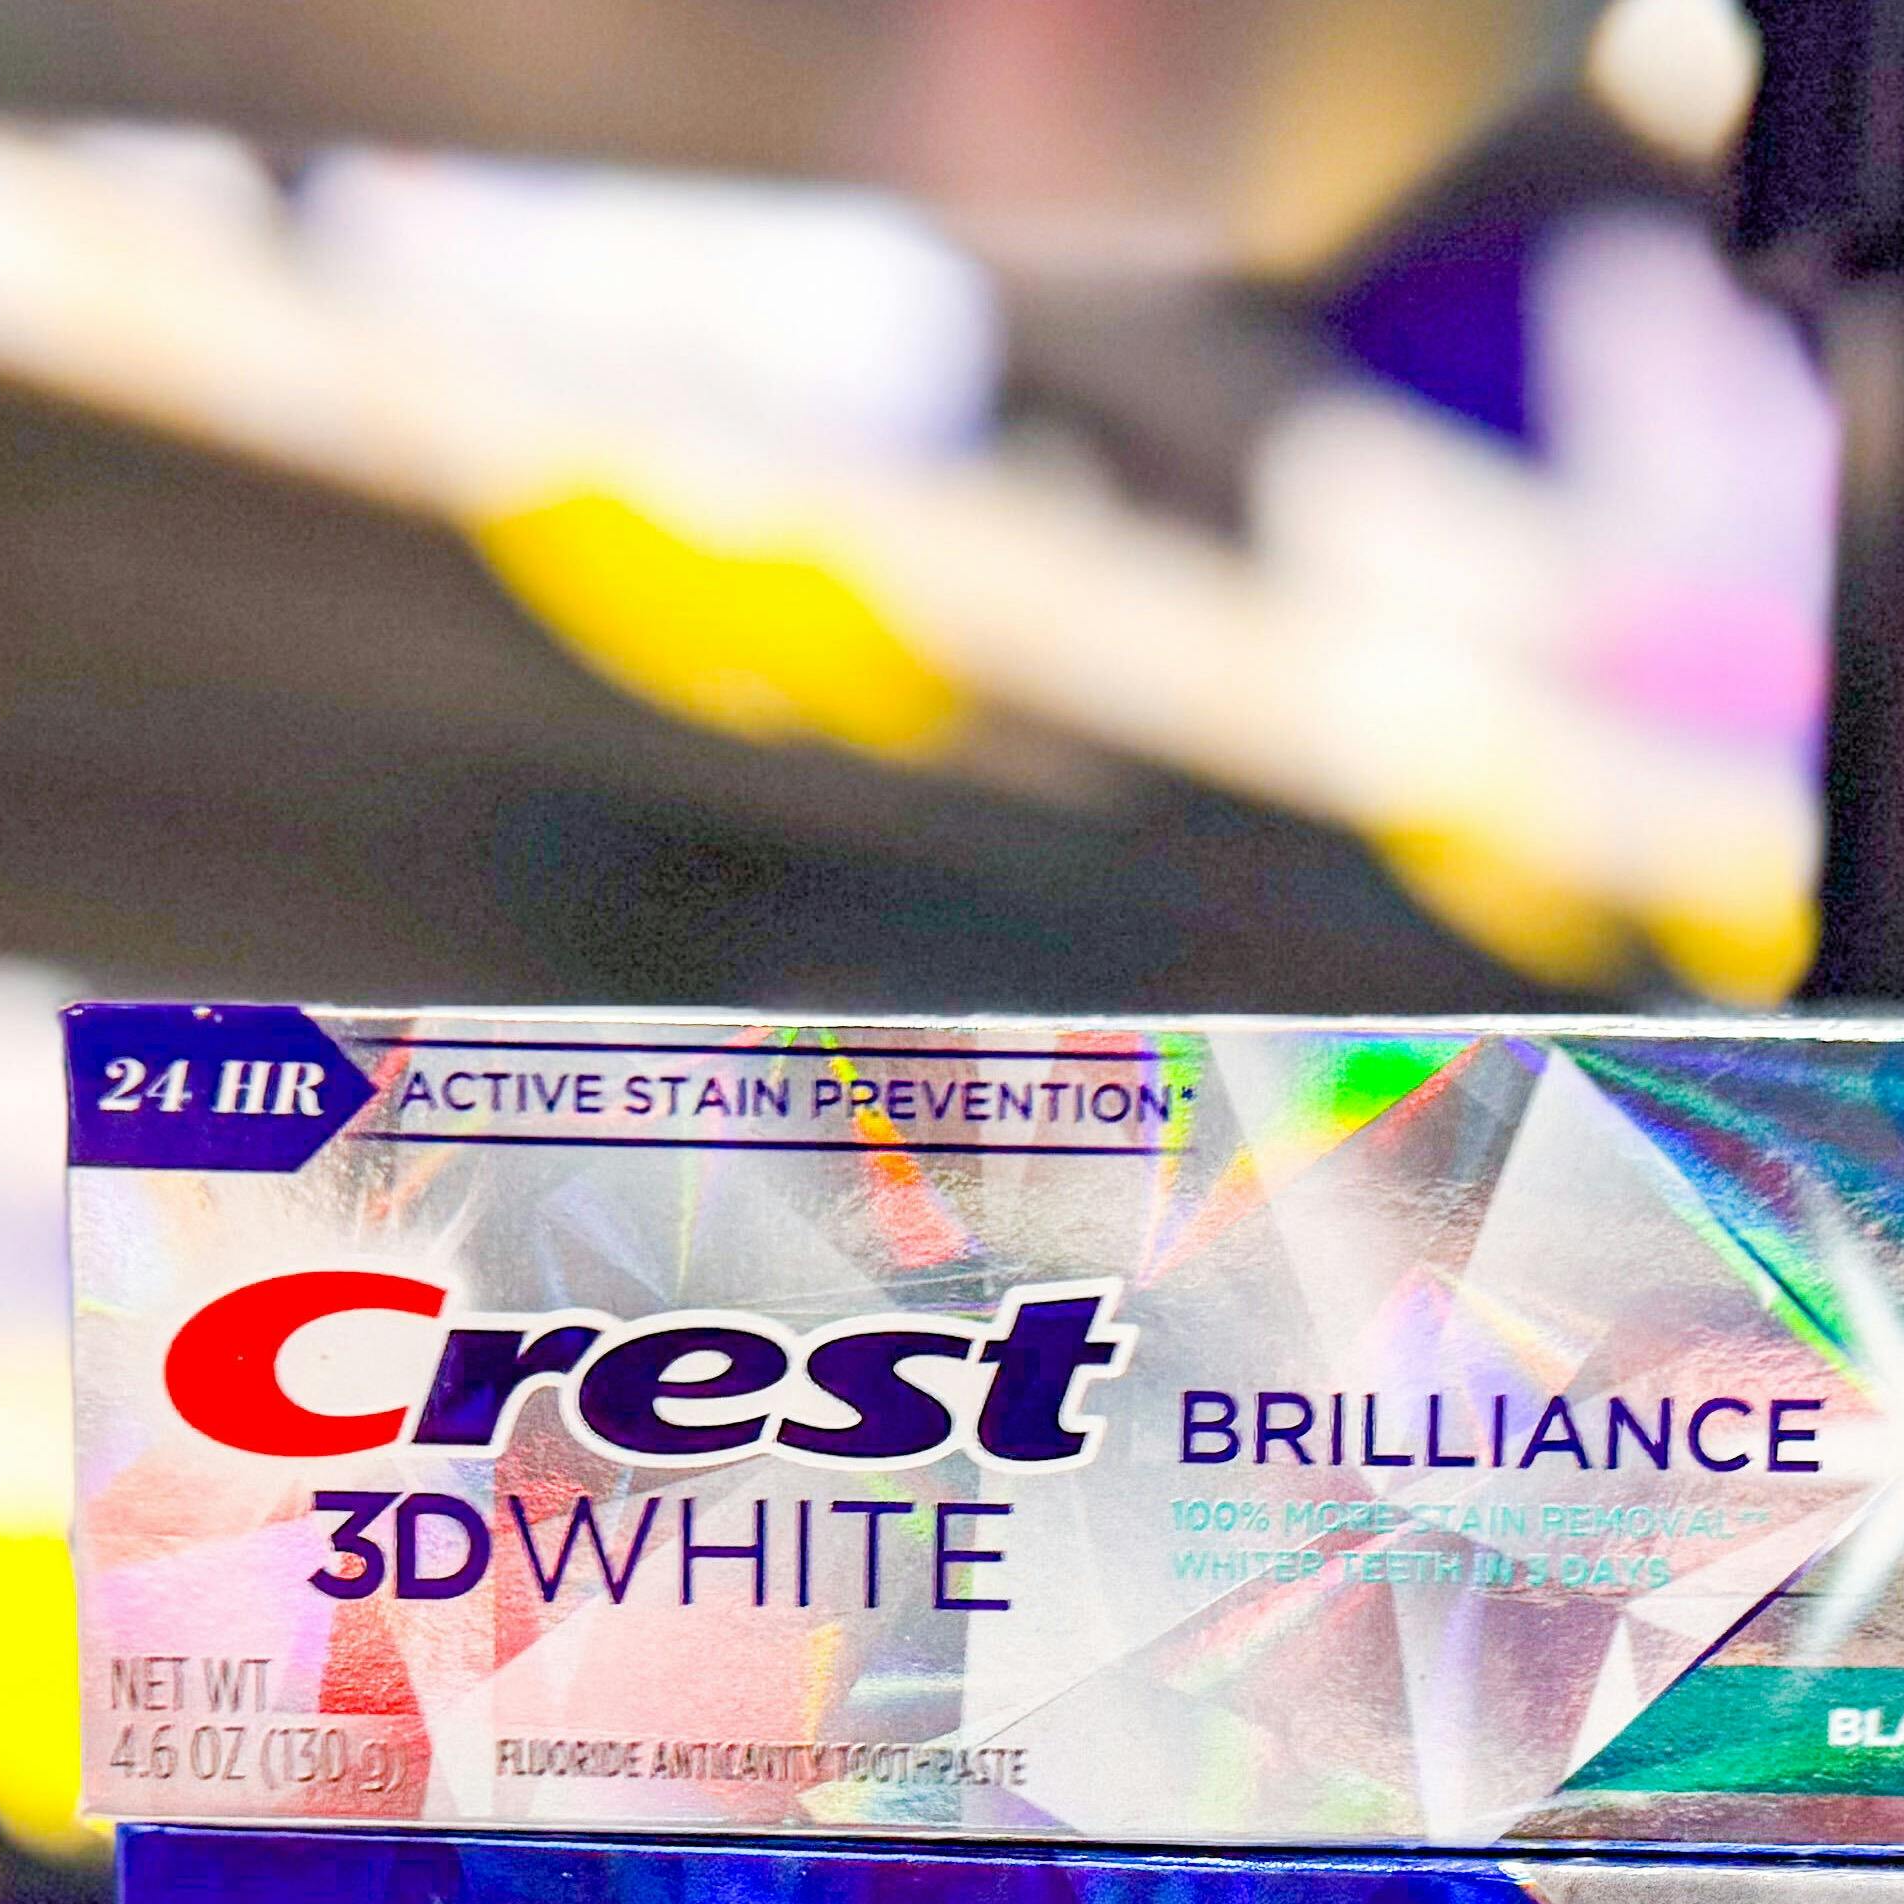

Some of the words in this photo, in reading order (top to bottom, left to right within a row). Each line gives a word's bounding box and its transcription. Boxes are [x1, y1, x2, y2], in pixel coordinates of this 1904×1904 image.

[97, 1057, 193, 1113] 24
[210, 1058, 326, 1117] HR
[397, 1070, 605, 1116] ACTIVE
[625, 1074, 789, 1119] STAIN
[162, 1268, 1122, 1464] Crest
[1178, 1389, 1825, 1475] BRILLIANCE
[1170, 1498, 1271, 1534] 100%
[1283, 1501, 1405, 1535] MORE
[1413, 1504, 1527, 1537] STAIN
[1170, 1550, 1328, 1584] WHITER
[1339, 1551, 1463, 1585] TEETH
[1476, 1551, 1512, 1586] IN
[1560, 1553, 1672, 1588] DAYS
[109, 1656, 192, 1712] NET
[202, 1657, 273, 1714] WT
[109, 1723, 180, 1781] 4.6
[190, 1724, 248, 1782] OZ
[258, 1726, 348, 1790] (130
[358, 1734, 409, 1793] g)
[496, 1737, 644, 1778] FLUORIDE
[650, 1740, 828, 1782] ANTICAVITY
[833, 1742, 1029, 1787] TOOTHPASTE
